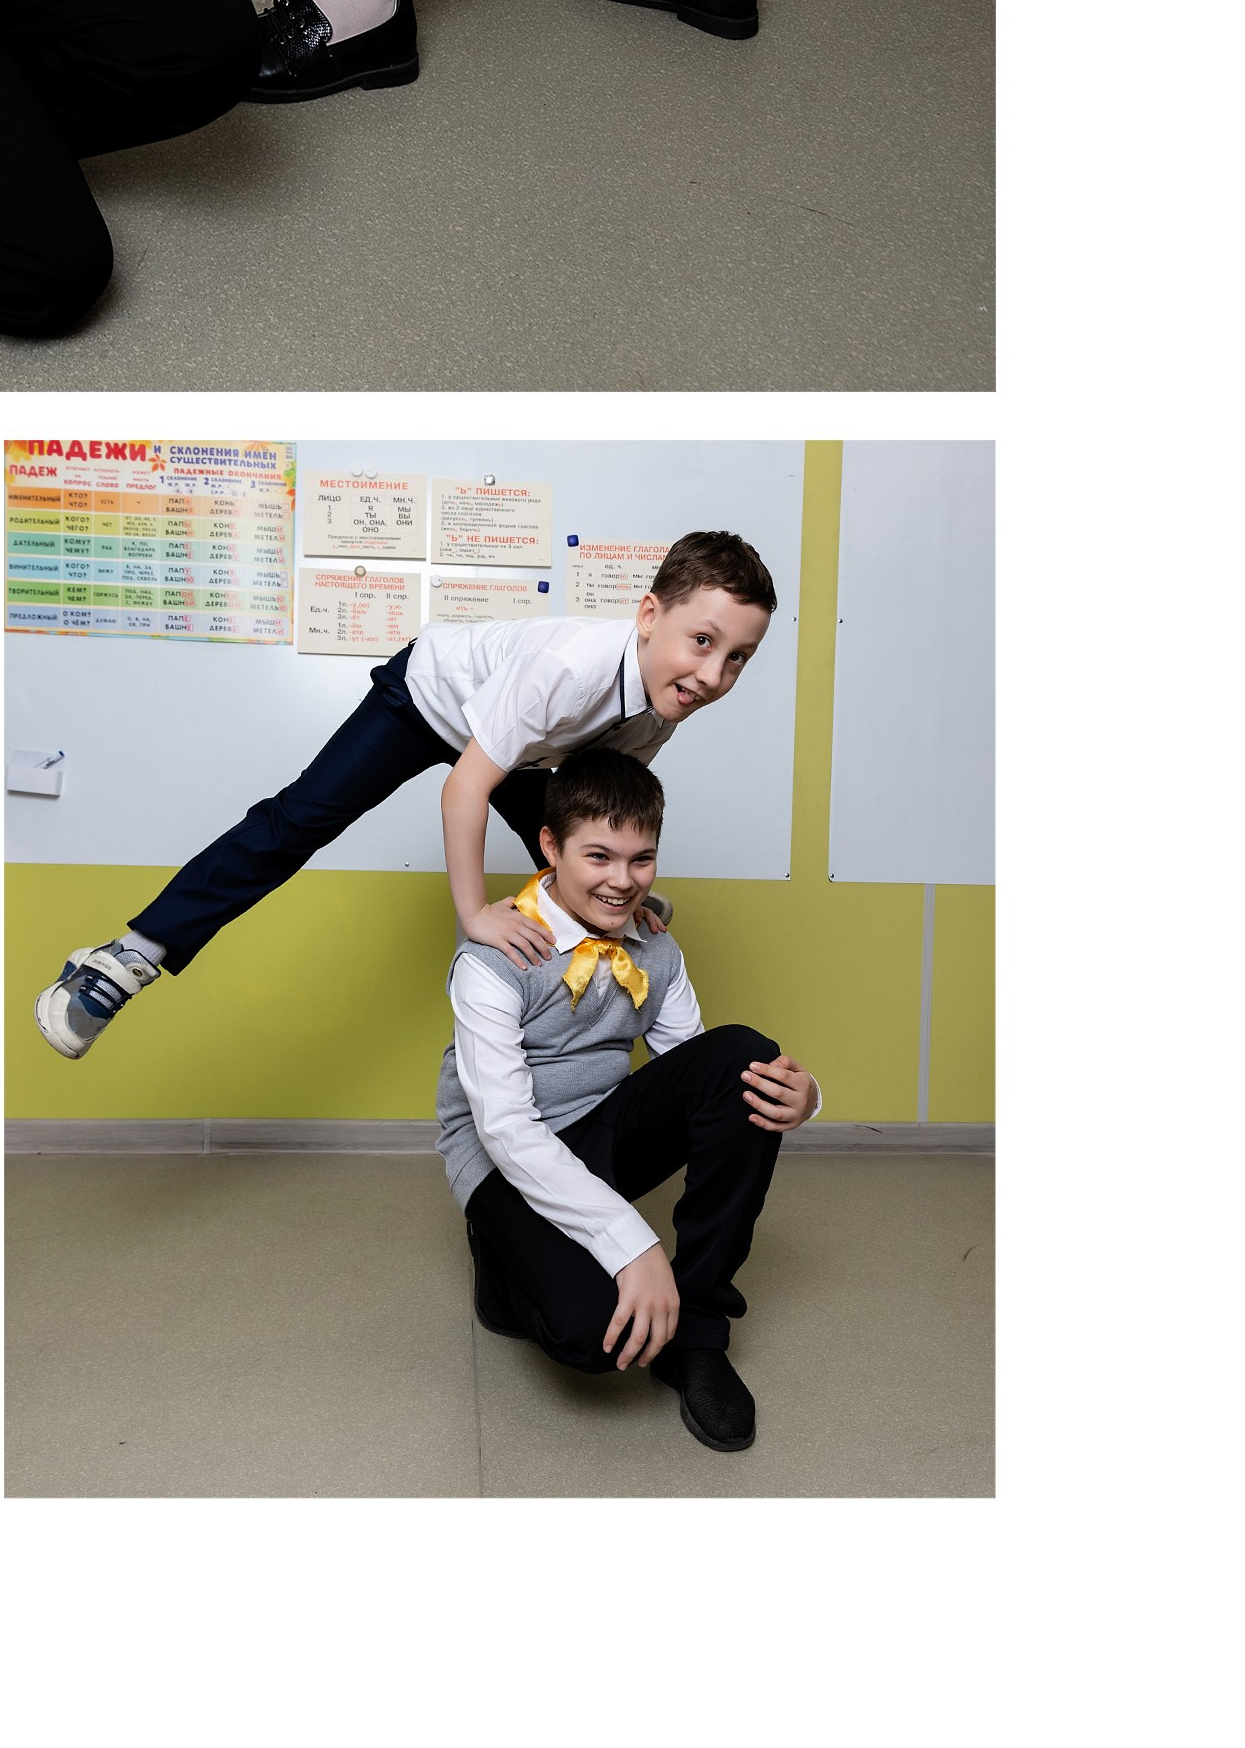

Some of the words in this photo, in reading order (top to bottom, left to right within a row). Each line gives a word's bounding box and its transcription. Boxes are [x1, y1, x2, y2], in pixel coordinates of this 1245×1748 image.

[28, 440, 147, 462] ПАДЕЖИ
[153, 445, 162, 454] И
[169, 446, 239, 458] СКЛОНЕНИЯ
[244, 448, 277, 460] ИМЁН
[170, 456, 277, 470] СУЩЕСТВИТЕЛЬНЫХ
[9, 464, 57, 478] ПАДЕЖ
[173, 468, 224, 476] ПАДЕЖНЫЕ
[228, 470, 281, 480] ОКОНЧАНИЯ
[319, 479, 409, 490] МЕСТОИМЕНИЕ
[475, 488, 531, 496] ПИШЕТСЯ:
[484, 536, 539, 544] ПИШЕТСЯ:
[579, 544, 631, 552] ИЗМЕНЕНИЕ
[315, 581, 367, 590] НАСТОЯЩЕГО
[443, 582, 487, 591] СПРЯЖЕНИЕ
